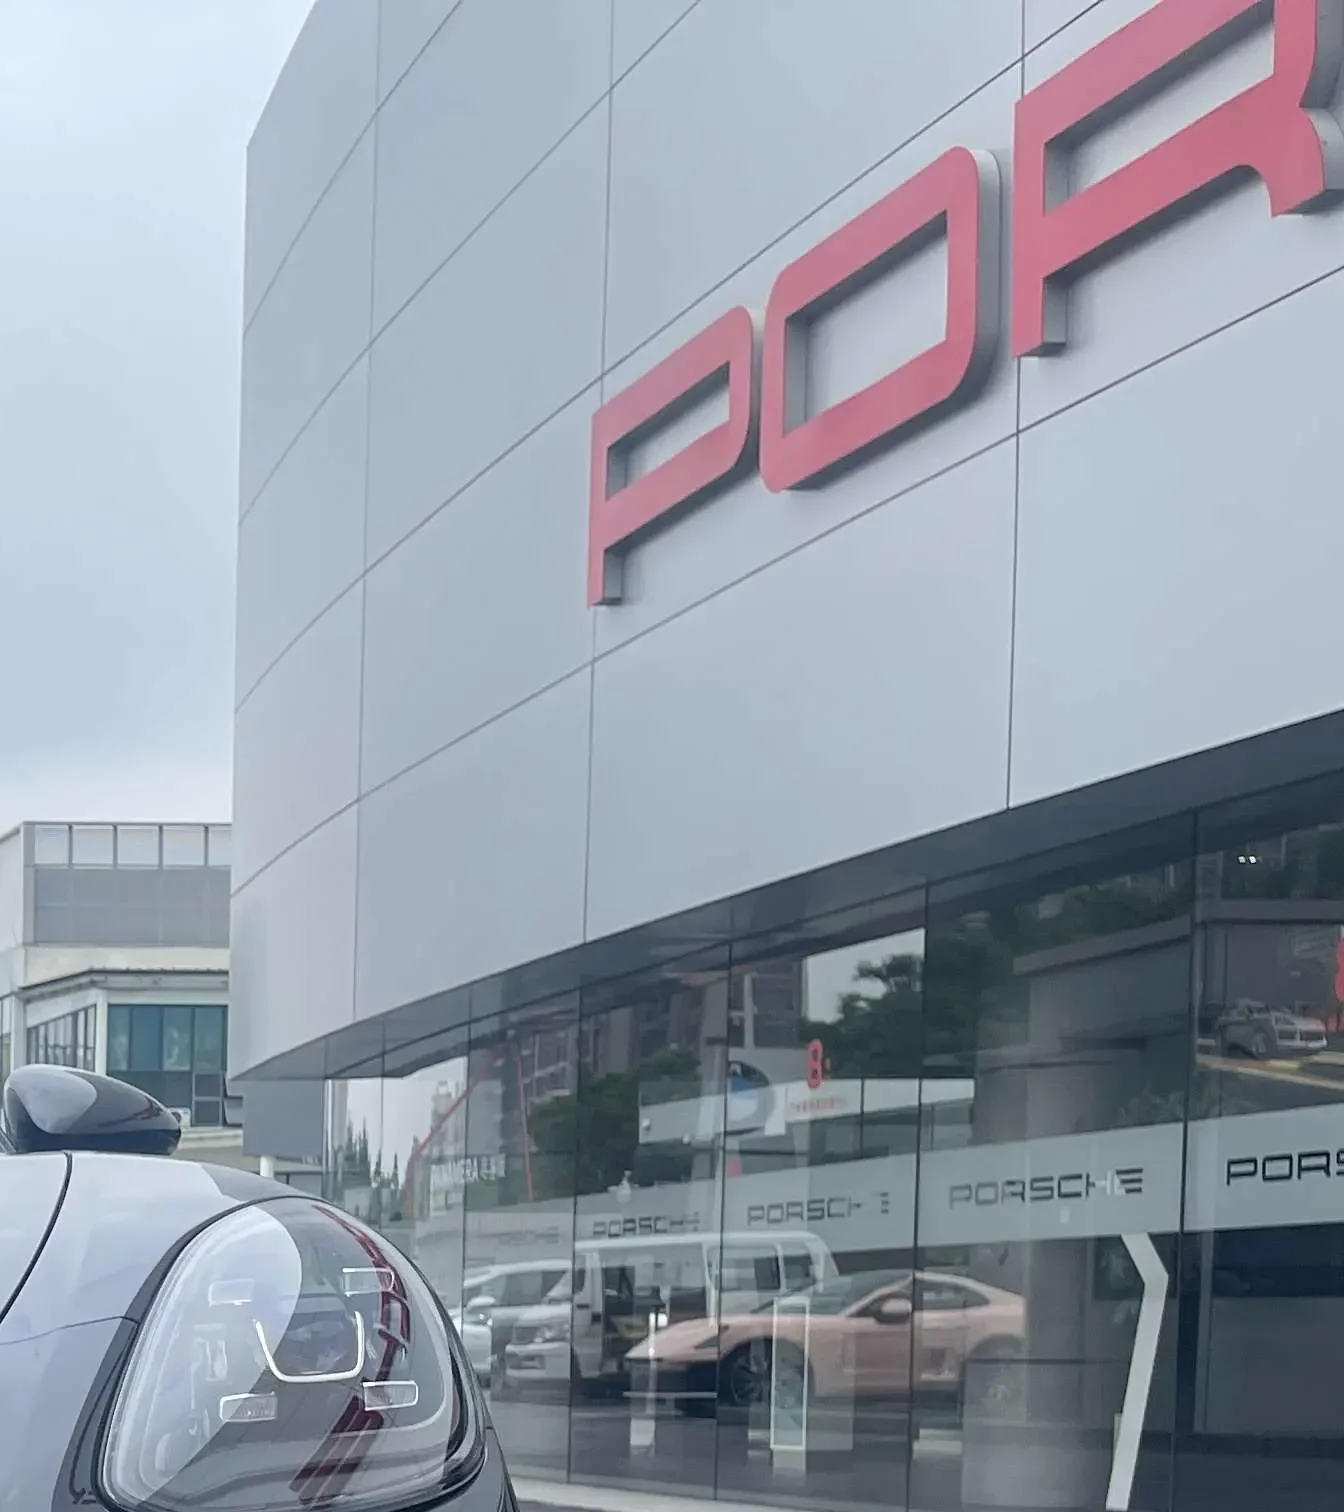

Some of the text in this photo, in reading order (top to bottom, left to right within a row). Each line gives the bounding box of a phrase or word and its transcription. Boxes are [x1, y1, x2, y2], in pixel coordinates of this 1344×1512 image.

[587, 0, 1326, 609] POR
[1225, 1149, 1344, 1186] POR
[948, 1167, 1144, 1209] PORSCHE
[748, 1191, 889, 1225] PORSCH
